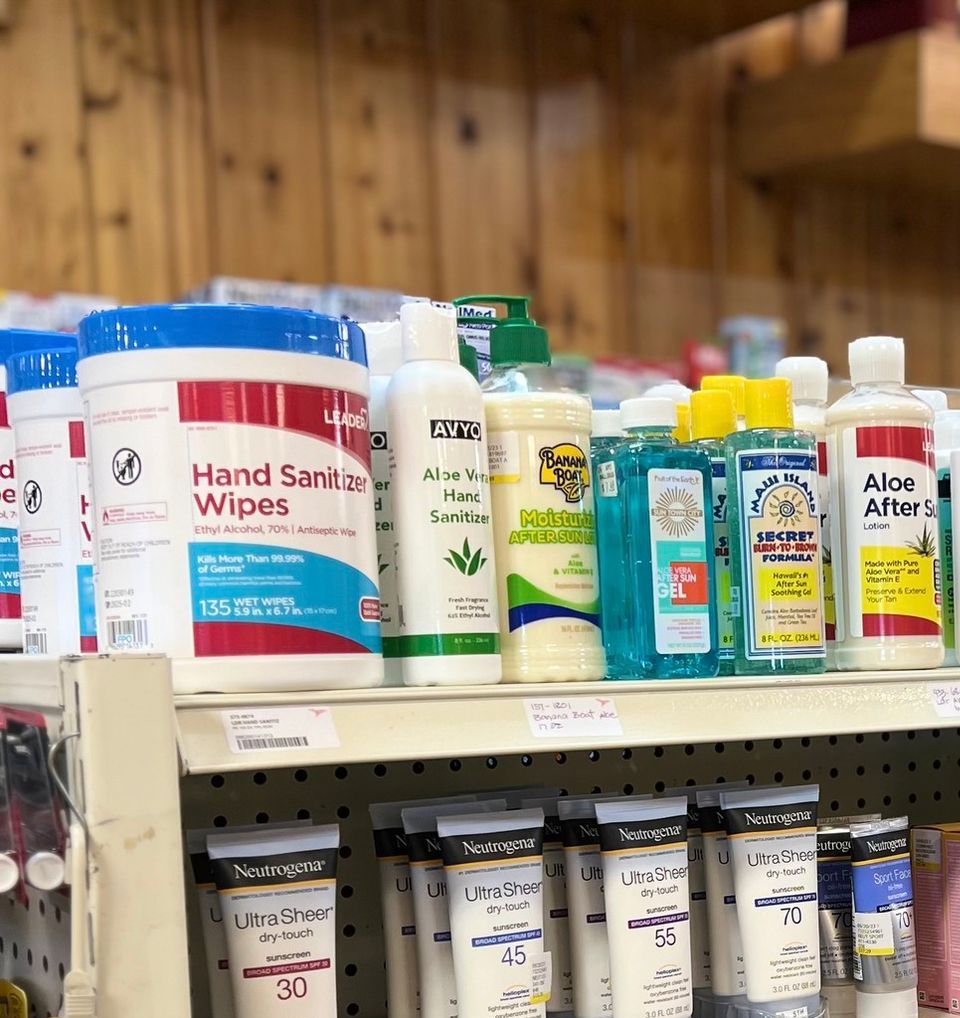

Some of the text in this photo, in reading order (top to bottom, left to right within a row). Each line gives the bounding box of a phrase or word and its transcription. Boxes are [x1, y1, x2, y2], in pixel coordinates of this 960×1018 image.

[431, 420, 481, 439] AVYO
[193, 463, 367, 494] Hand Sanitizer
[863, 473, 915, 493] Aloe
[444, 490, 480, 503] Hand
[193, 493, 289, 520] Wipes
[430, 510, 489, 525] Sanitizer
[863, 521, 890, 530] Lotion
[195, 525, 220, 535] Ethyl
[223, 525, 265, 535] Alcohol,
[268, 525, 289, 534] 70%
[297, 526, 339, 536] Antiseptic
[509, 530, 583, 544] AFTER SUN
[757, 531, 814, 543] SECRET
[658, 574, 697, 583] AFTER SUN
[776, 580, 793, 589] After
[657, 583, 687, 599] GEL
[771, 589, 812, 597] Soothing Gel
[199, 597, 295, 616] 135 WET WIPES
[573, 711, 595, 720] Boat
[745, 811, 810, 828] Neutrogena
[620, 826, 679, 842] Neutrogena
[462, 838, 532, 856] Neutrogena
[868, 838, 906, 853] Neutrogena
[748, 849, 817, 868] Ultra Sheer
[233, 859, 320, 880] Neutrogena
[621, 867, 689, 887] Ultra Sheer
[766, 866, 806, 880] dry-touch
[465, 881, 543, 903] Ultra Sheer
[641, 884, 679, 898] dry-touch
[772, 885, 805, 895] sunscreen
[487, 900, 530, 916] dry-touch
[646, 904, 678, 915] sunscreen
[235, 908, 329, 930] Ultra Sheer
[781, 907, 802, 926] 70
[493, 921, 528, 932] sunscreen
[259, 928, 313, 944] dry-touch
[655, 928, 677, 948] 55
[266, 951, 311, 962] sunscreen
[501, 945, 526, 967] 45
[277, 977, 307, 1000] 30
